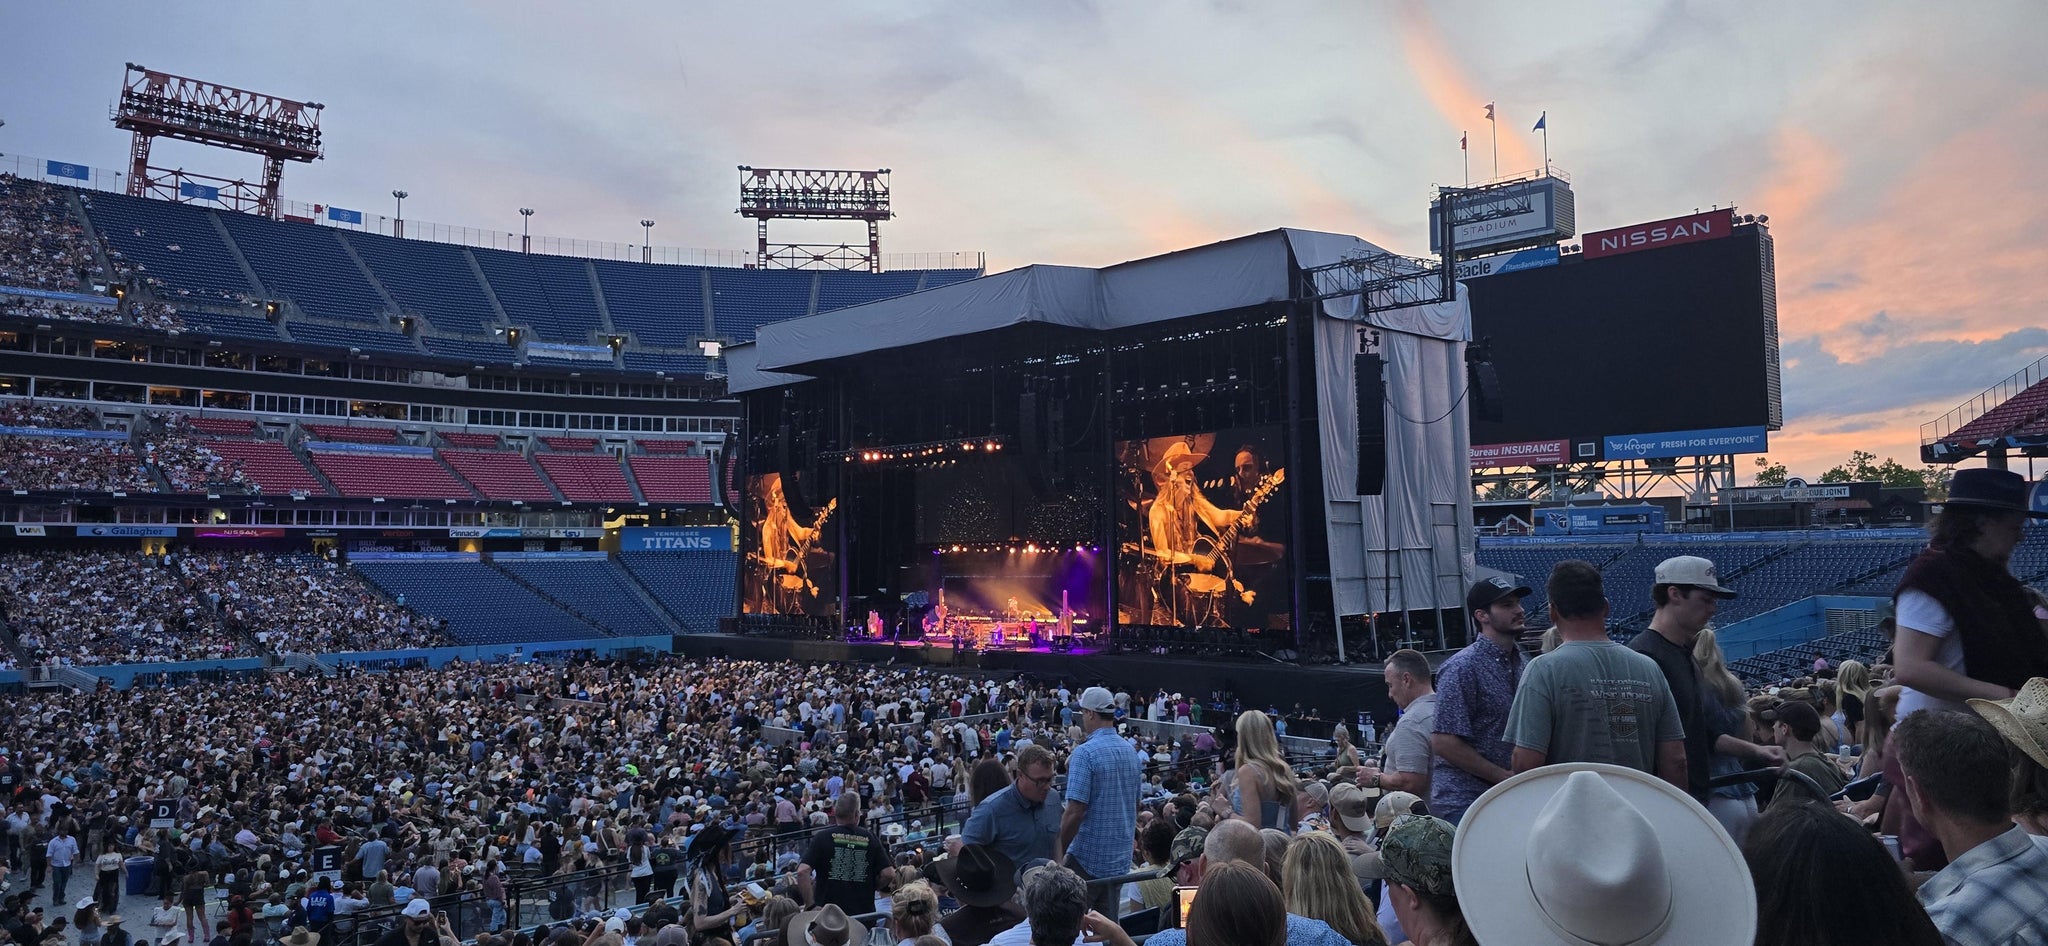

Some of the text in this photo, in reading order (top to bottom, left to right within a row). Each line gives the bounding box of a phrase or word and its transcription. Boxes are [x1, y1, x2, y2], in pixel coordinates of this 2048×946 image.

[1463, 219, 1517, 236] STADIUM
[1601, 220, 1710, 251] NISSAN
[24, 428, 54, 436] TITANS
[1470, 443, 1561, 457] Bureau INSURANCE
[1624, 438, 1655, 455] Kroger
[1661, 441, 1687, 449] FRESH
[1689, 439, 1706, 447] FOR
[1825, 487, 1847, 496] JOINT
[111, 527, 163, 536] Gallagher
[450, 529, 480, 537] Pinnacle
[642, 537, 711, 548] TITANS
[158, 805, 170, 817] D
[322, 854, 333, 869] E
